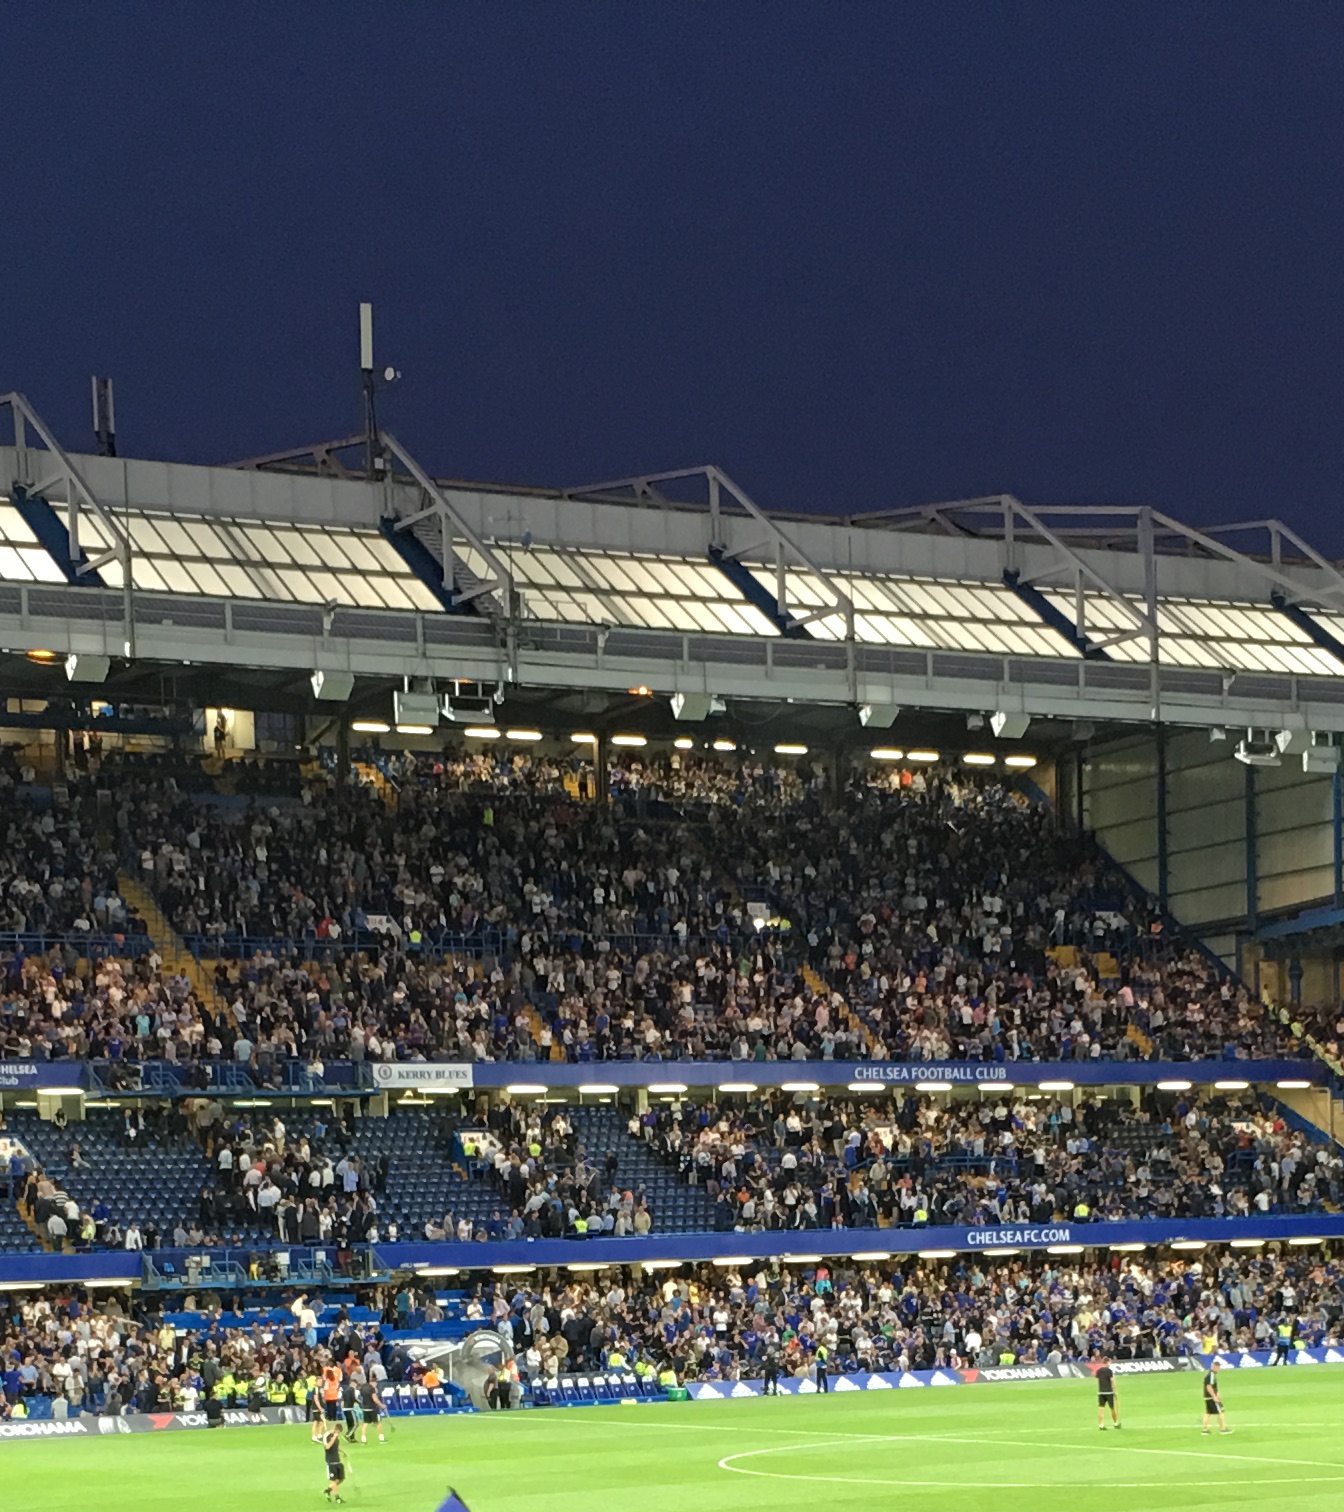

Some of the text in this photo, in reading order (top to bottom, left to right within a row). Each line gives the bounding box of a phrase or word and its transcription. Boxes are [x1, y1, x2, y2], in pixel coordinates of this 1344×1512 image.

[398, 1070, 467, 1080] KERRY BLUES
[855, 1067, 1006, 1080] CHELSEA FOOTBALL CLUB
[2, 1142, 8, 1151] 3
[981, 1367, 1054, 1381] YOKOHAMA
